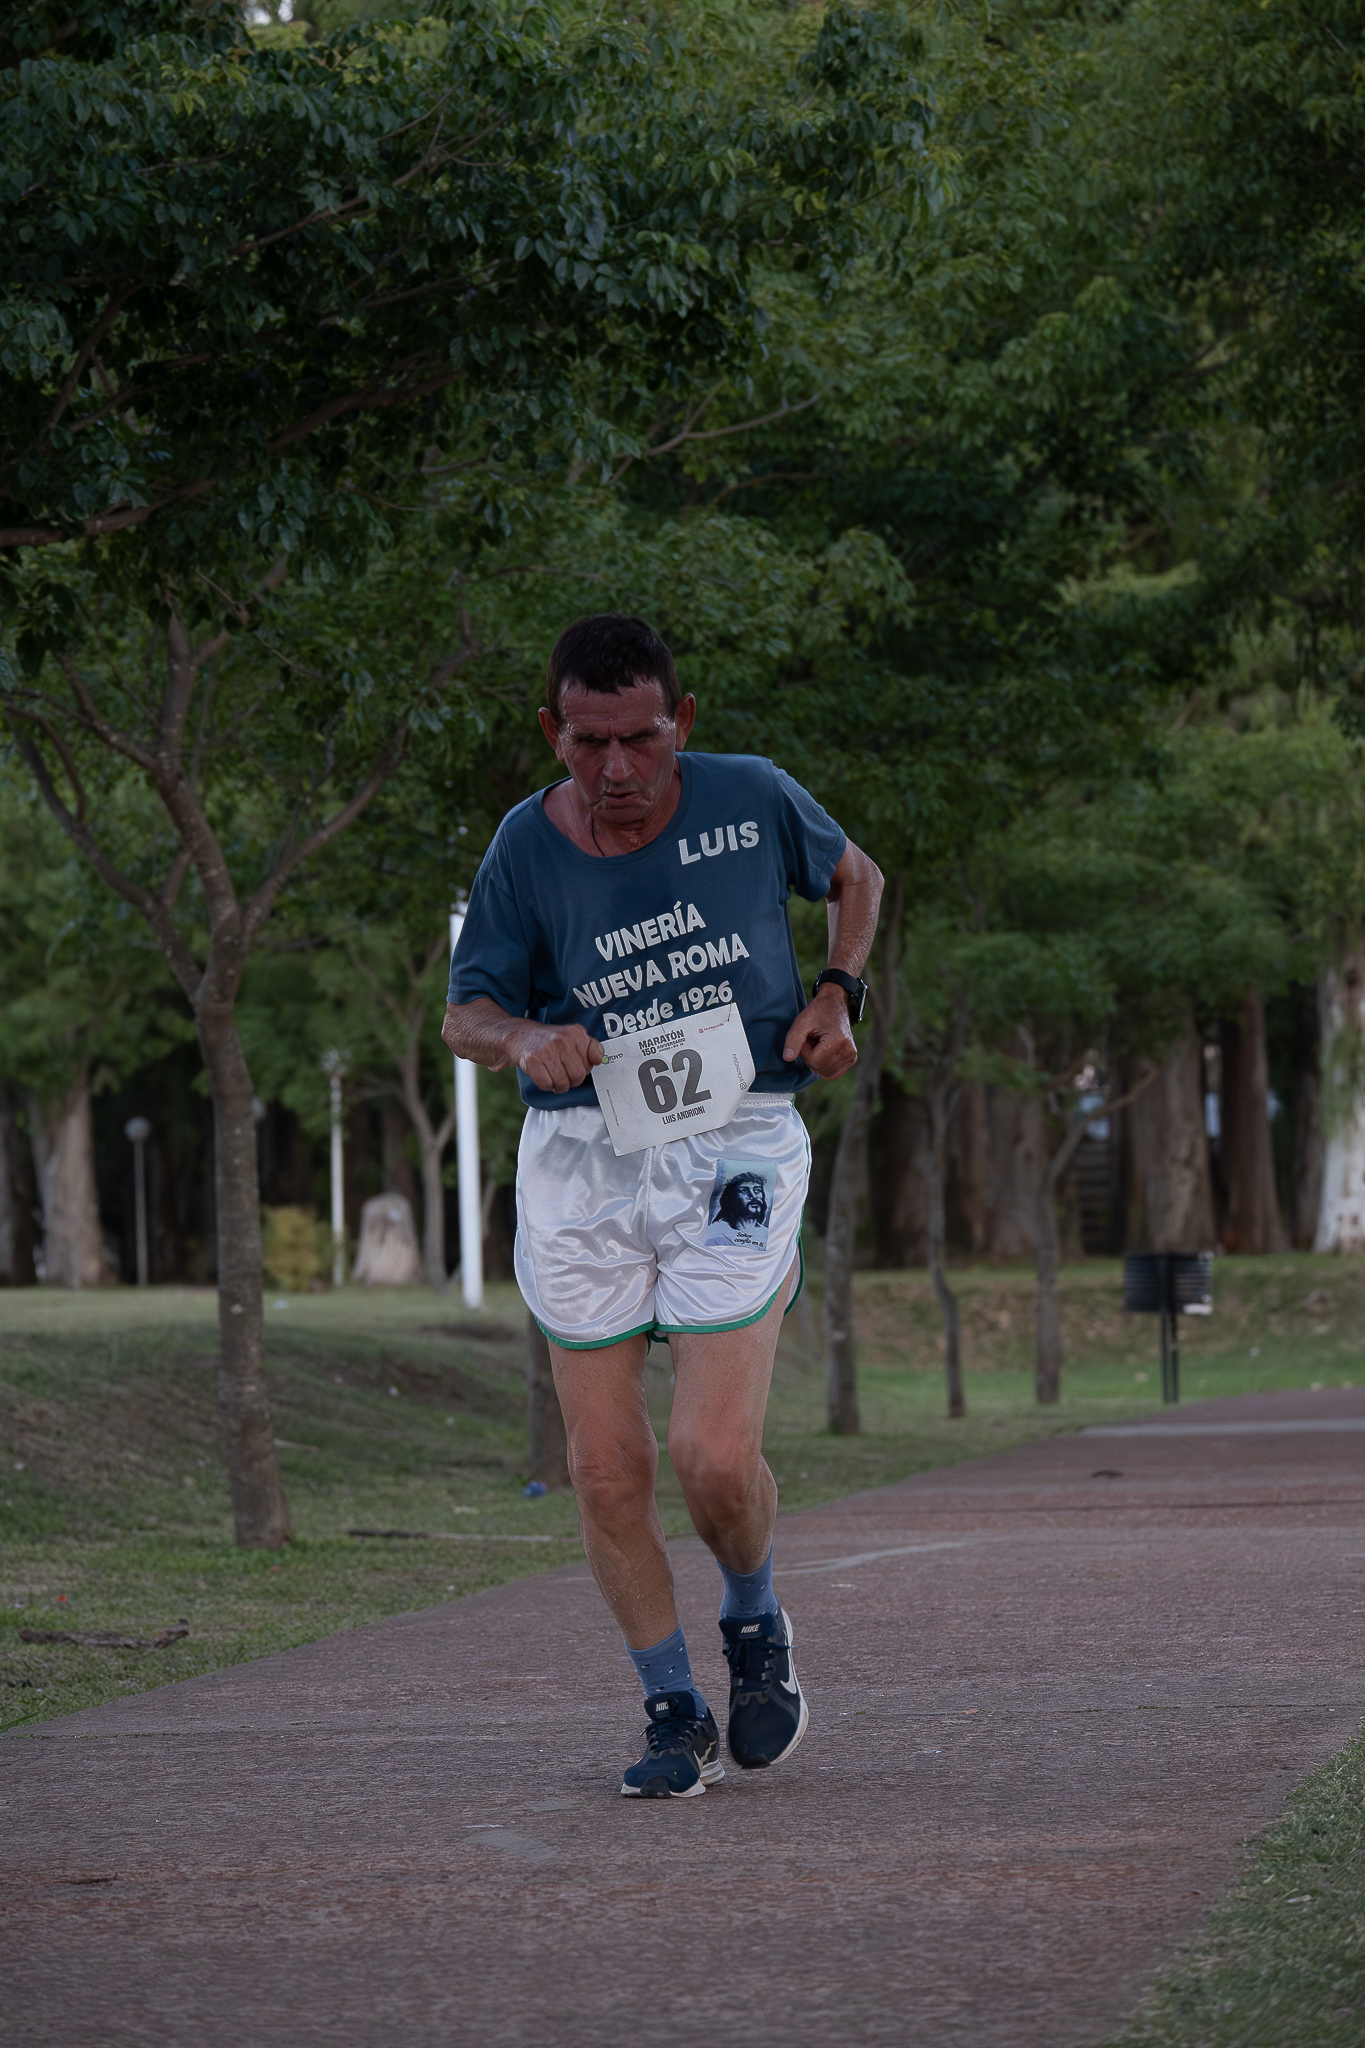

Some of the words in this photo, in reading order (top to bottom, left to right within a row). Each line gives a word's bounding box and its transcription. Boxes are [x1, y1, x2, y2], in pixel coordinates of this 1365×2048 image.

[678, 821, 760, 866] LUIS
[595, 901, 707, 961] VINERÍA
[573, 959, 666, 1009] NUEVA
[668, 933, 750, 979] ROMA
[603, 998, 674, 1038] Desde
[679, 981, 733, 1013] 1926
[638, 1029, 685, 1050] MARATÓN
[641, 1047, 657, 1057] 150
[638, 1049, 712, 1114] 62
[662, 1115, 677, 1125] LUIS
[676, 1106, 706, 1121] ANDRIONI
[741, 1623, 760, 1634] NIKE
